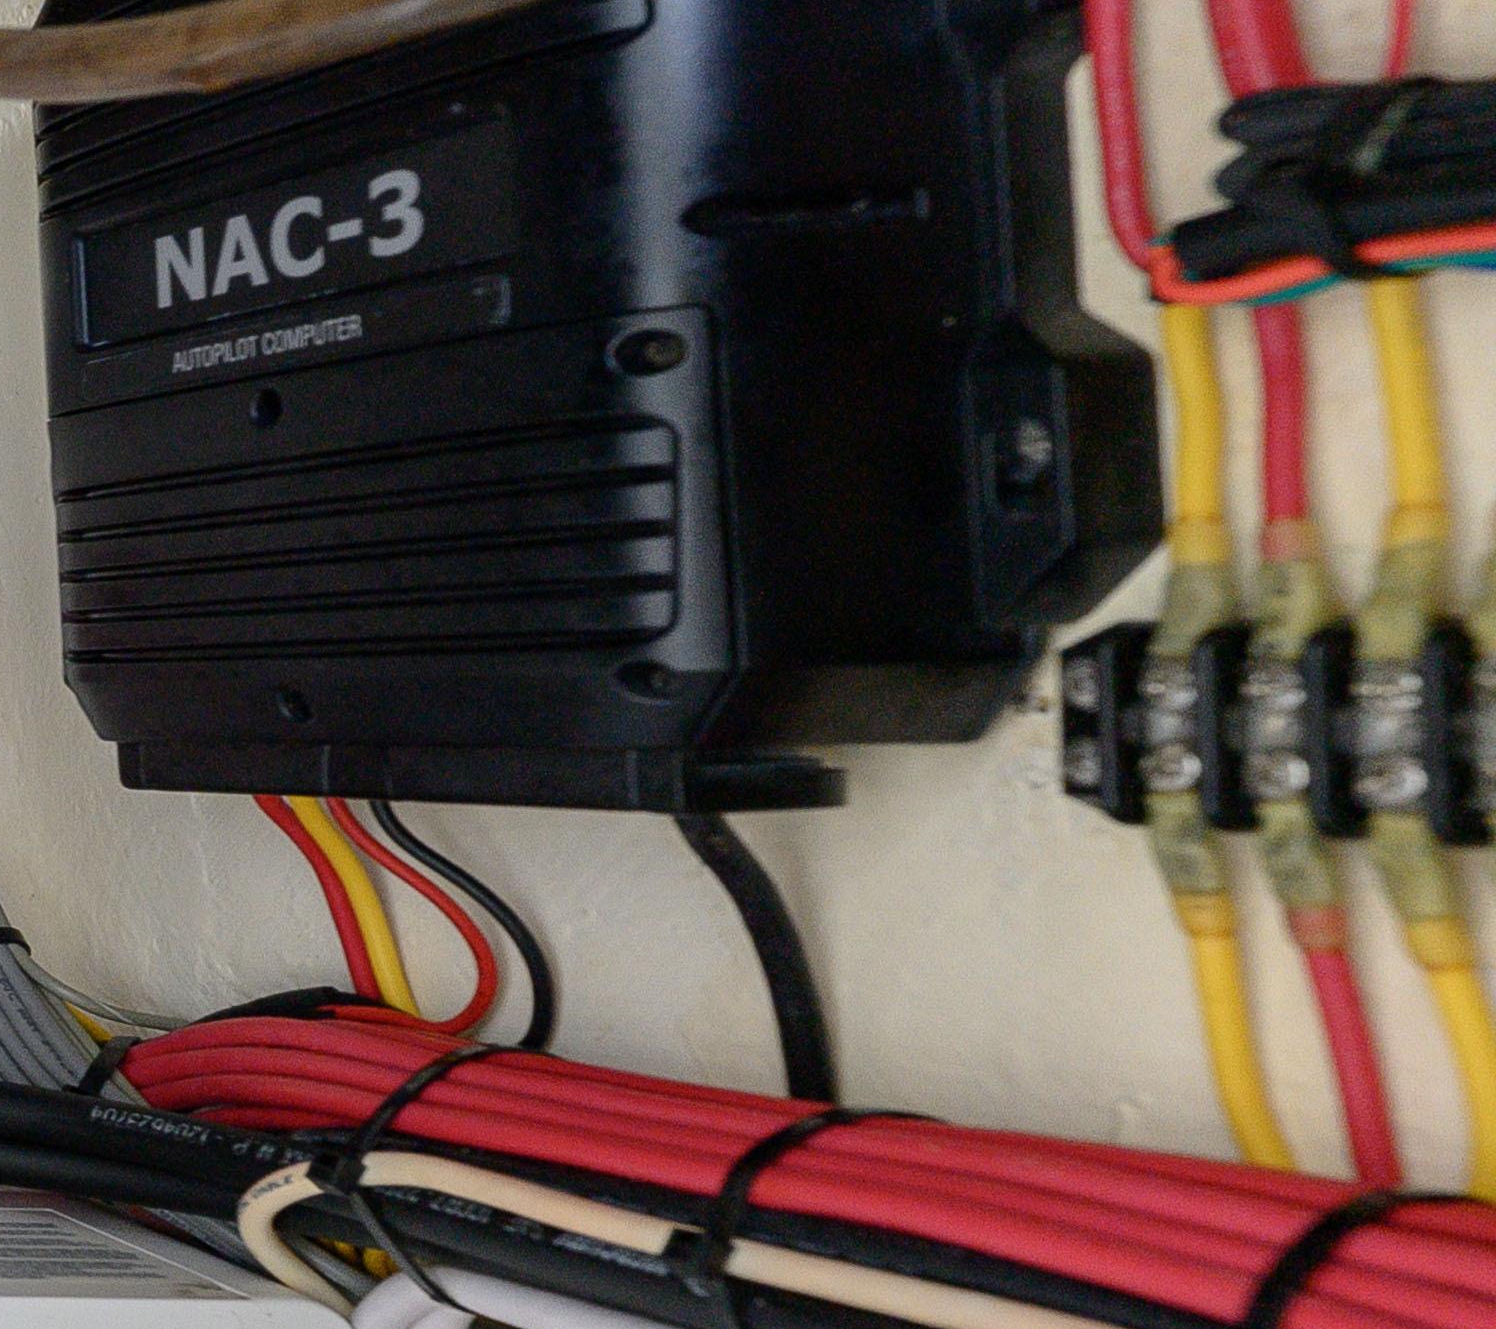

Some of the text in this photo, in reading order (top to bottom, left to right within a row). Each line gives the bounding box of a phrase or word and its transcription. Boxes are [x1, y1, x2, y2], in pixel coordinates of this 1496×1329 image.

[154, 169, 424, 310] NAC-3
[172, 314, 363, 374] AUTOPILOT COMPUTER
